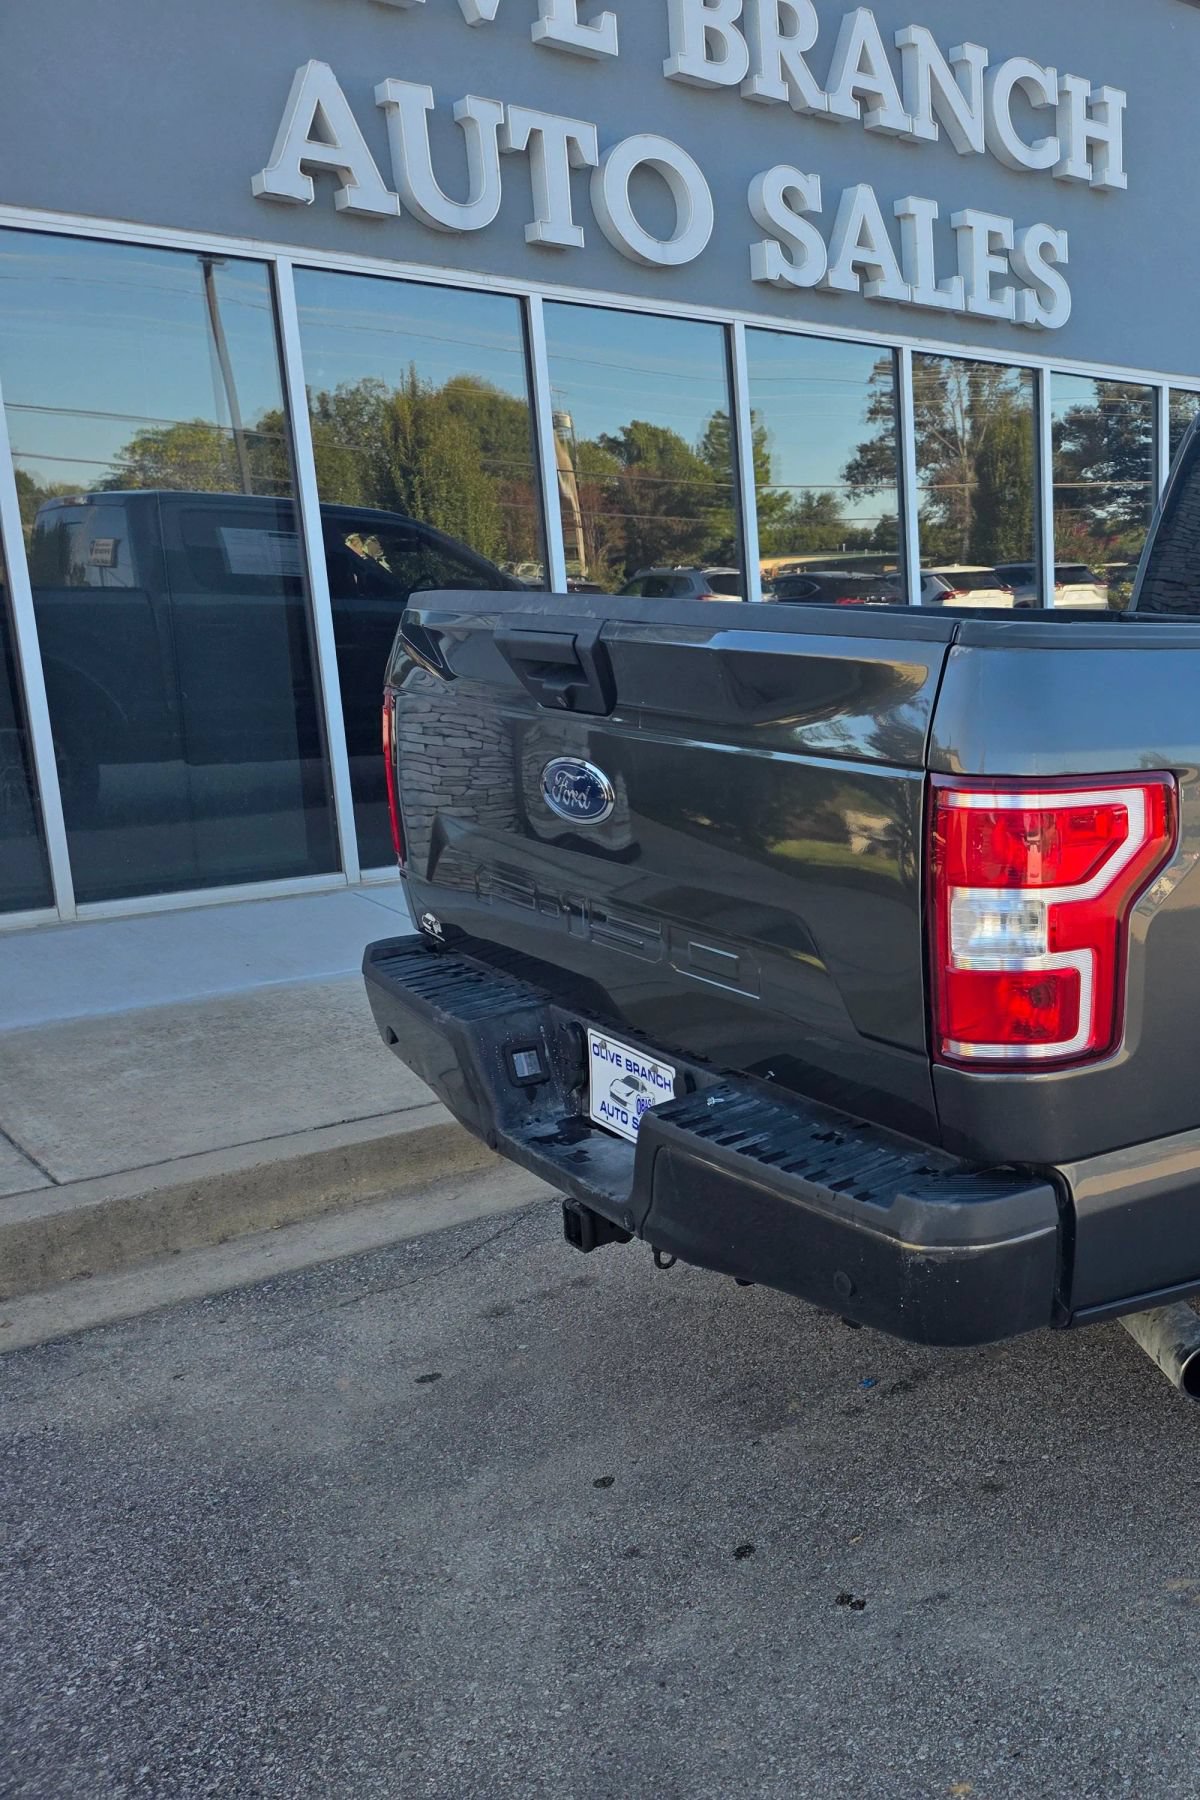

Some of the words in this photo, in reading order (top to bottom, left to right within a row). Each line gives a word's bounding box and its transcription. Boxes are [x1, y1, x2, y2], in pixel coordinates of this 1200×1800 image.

[662, 0, 1128, 191] BRANCH
[251, 59, 714, 268] AUTO
[748, 164, 1071, 330] SALES
[552, 770, 591, 810] Ford
[592, 1043, 622, 1068] OLIVE
[625, 1058, 671, 1092] BRANCH
[600, 1100, 629, 1125] AUTO
